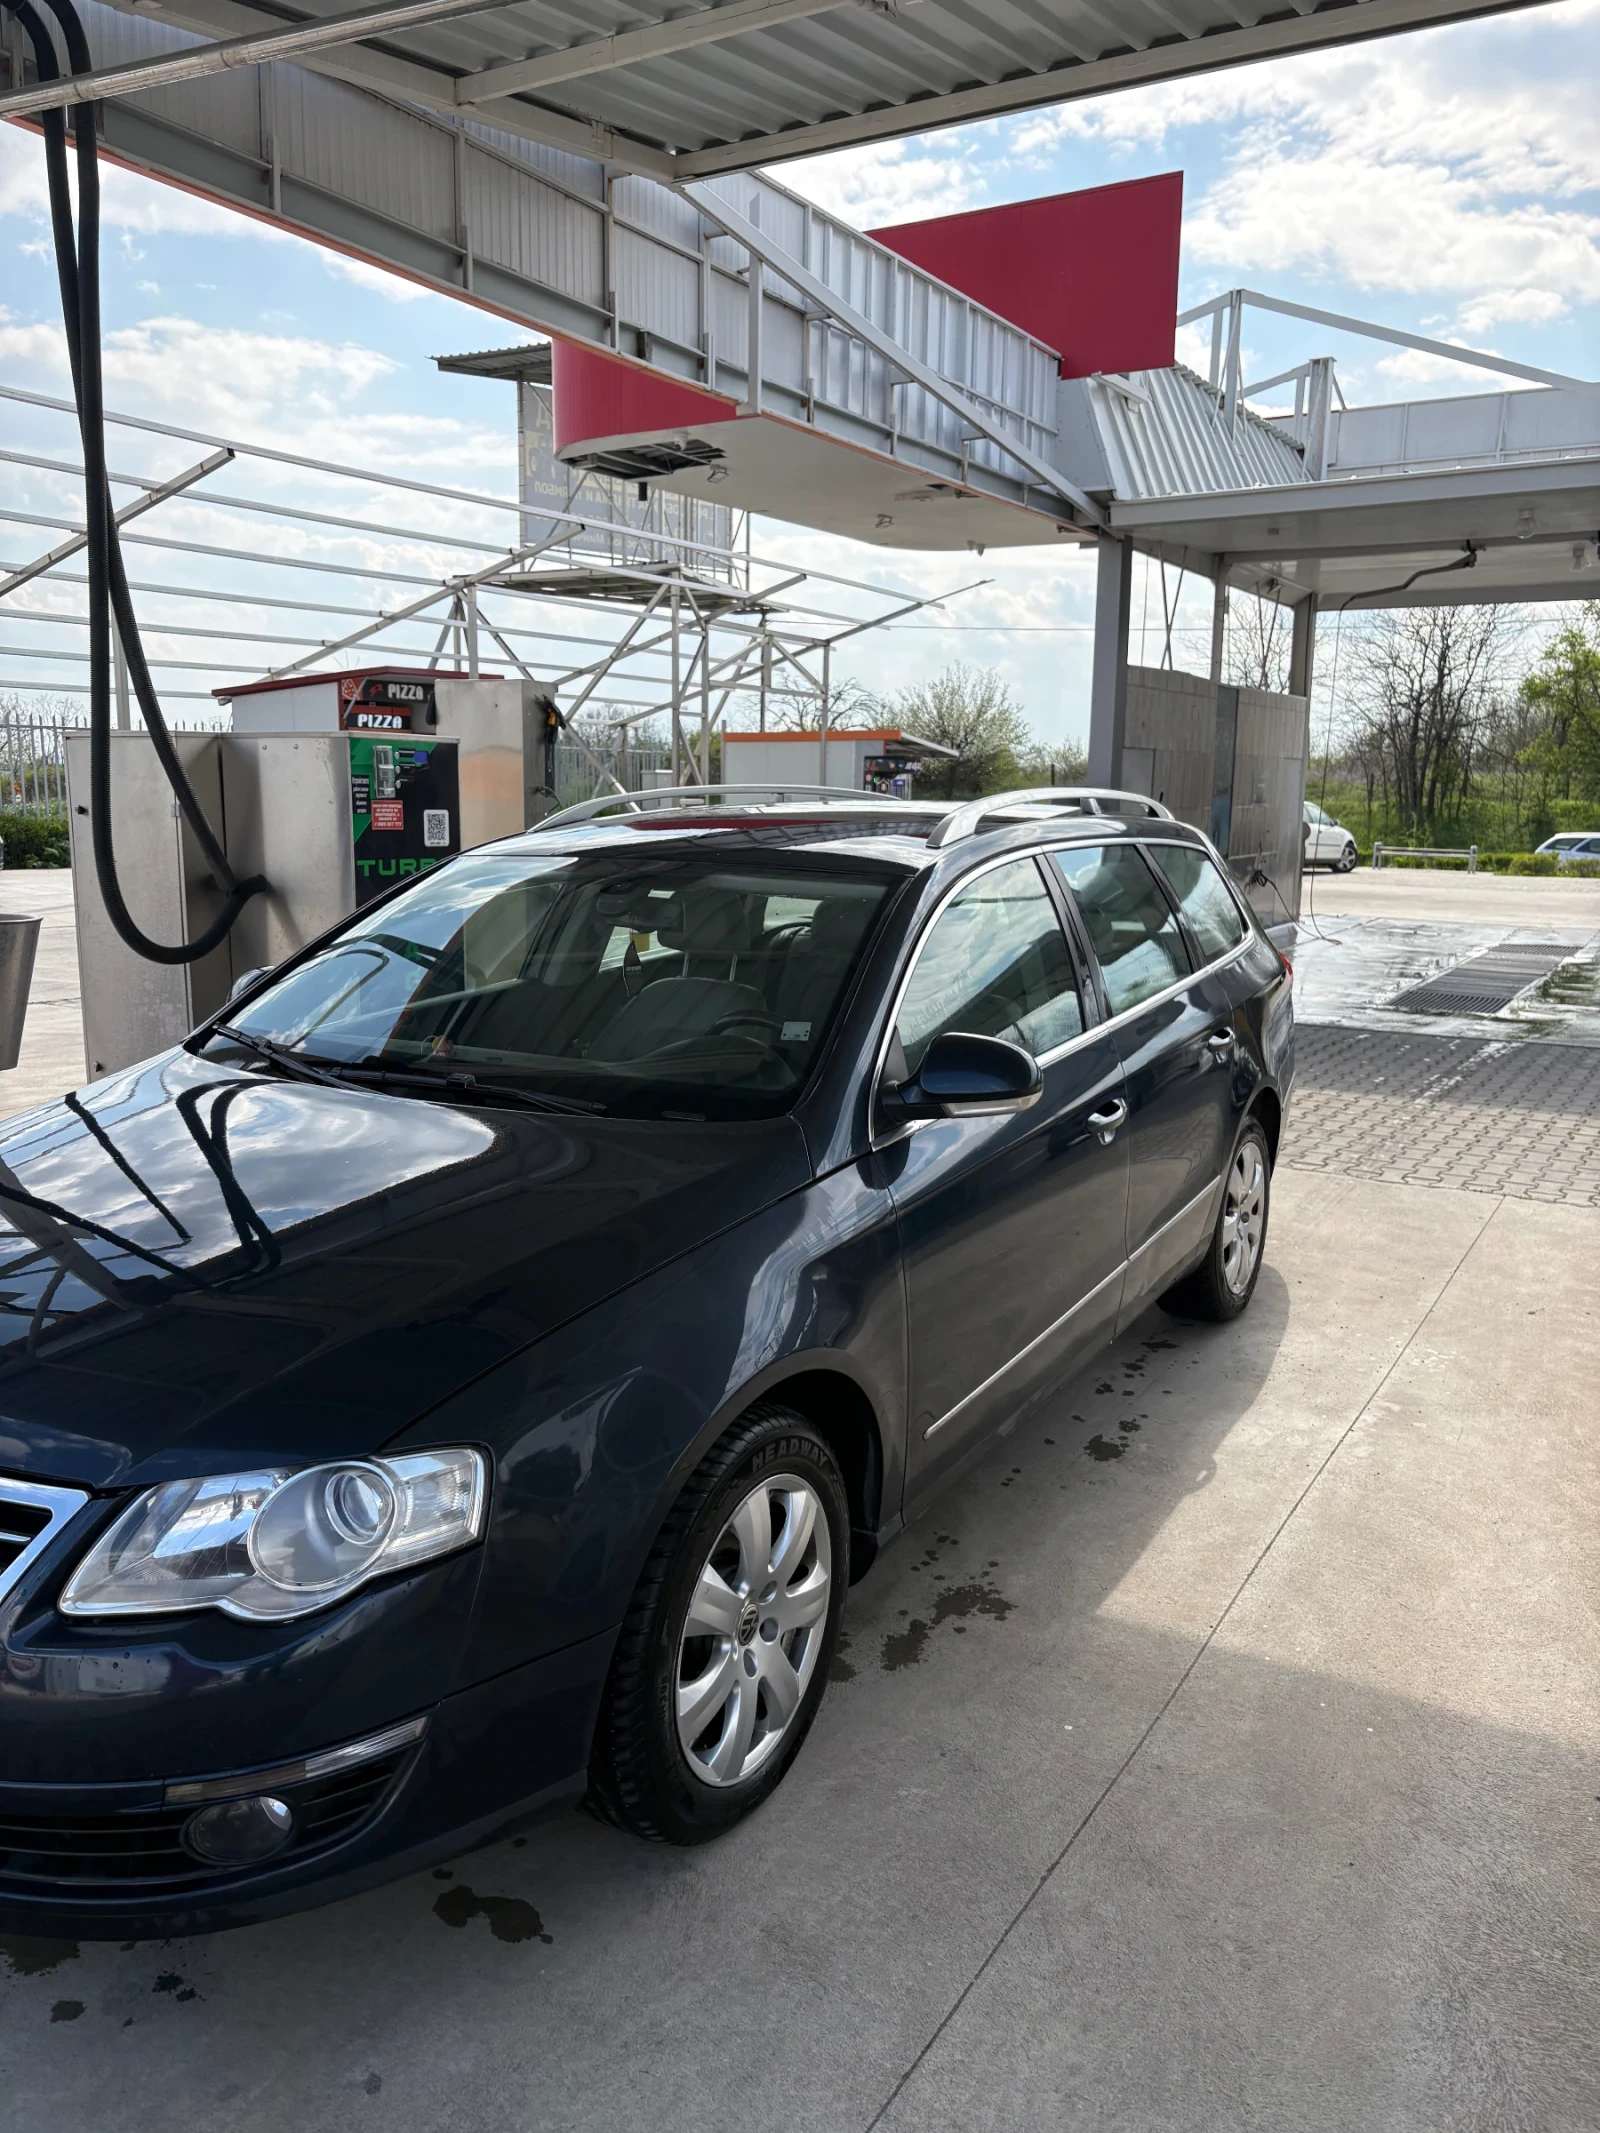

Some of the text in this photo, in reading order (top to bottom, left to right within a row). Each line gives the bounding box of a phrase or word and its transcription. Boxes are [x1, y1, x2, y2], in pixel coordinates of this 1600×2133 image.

[388, 683, 424, 700] PIZZA
[357, 714, 403, 729] PIZZA
[752, 1438, 828, 1474] HEADWAY
